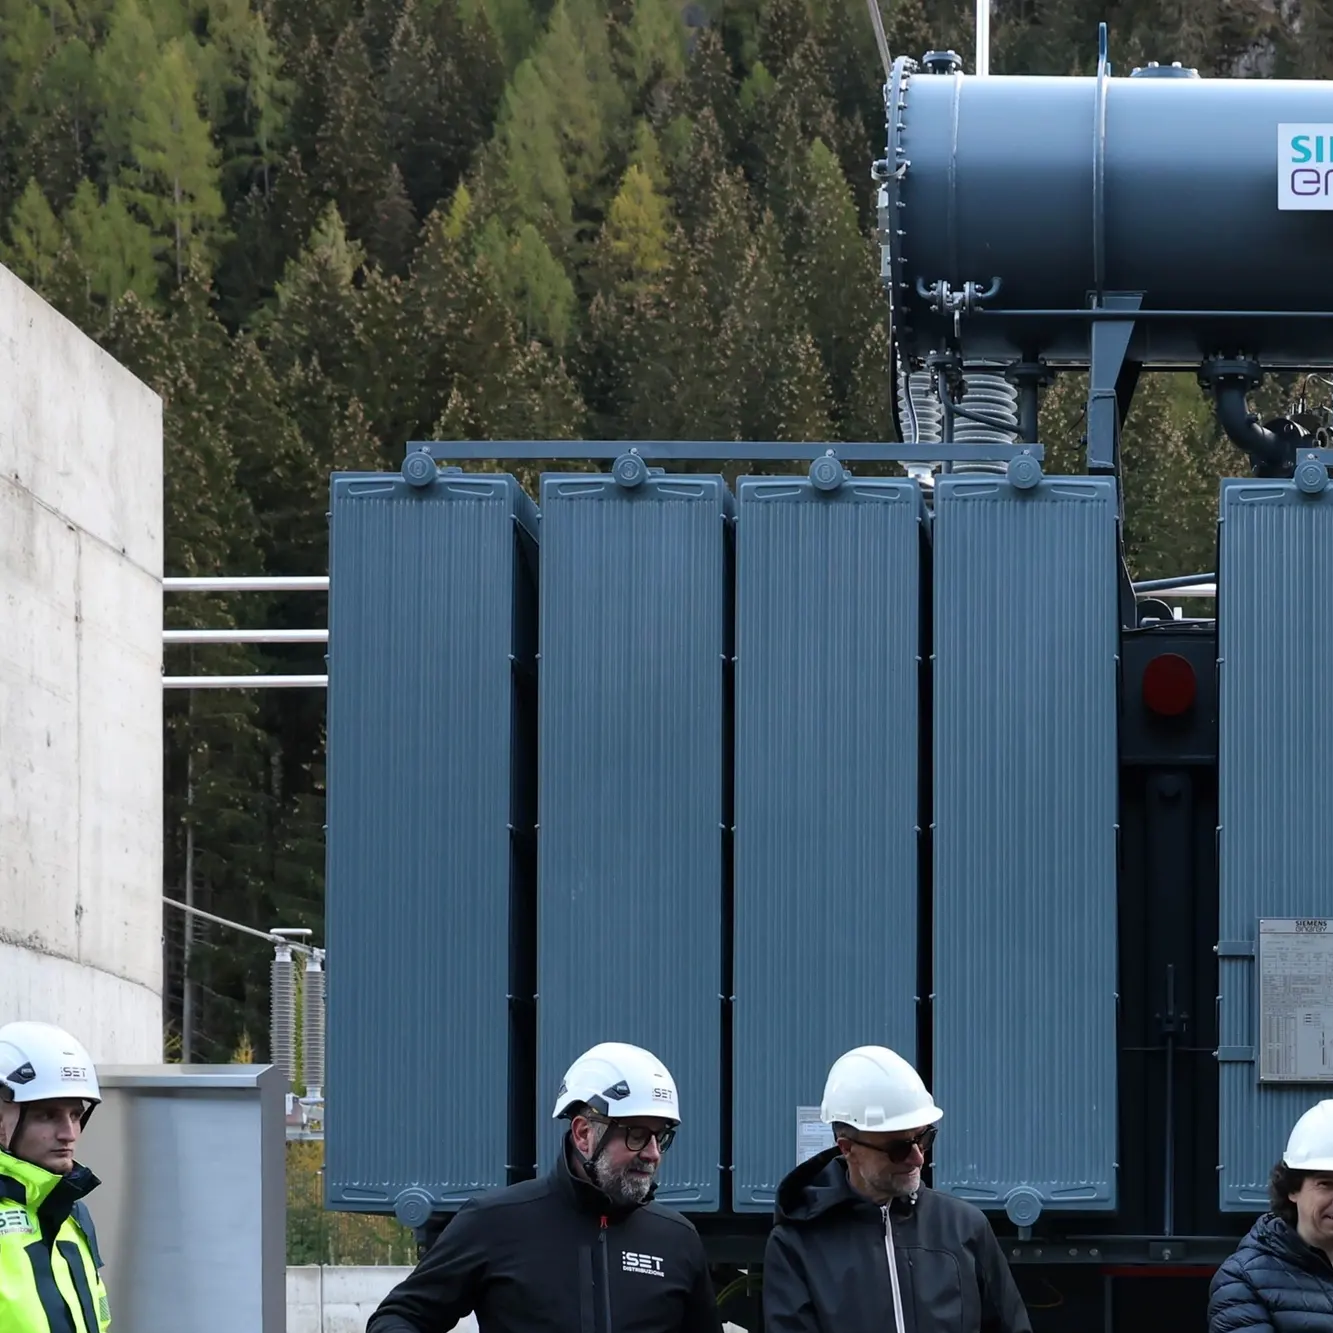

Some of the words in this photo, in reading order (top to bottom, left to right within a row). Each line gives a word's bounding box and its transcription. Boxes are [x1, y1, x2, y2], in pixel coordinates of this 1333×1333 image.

[61, 1066, 87, 1077] SET
[653, 1087, 673, 1099] SET
[625, 1251, 664, 1270] SET
